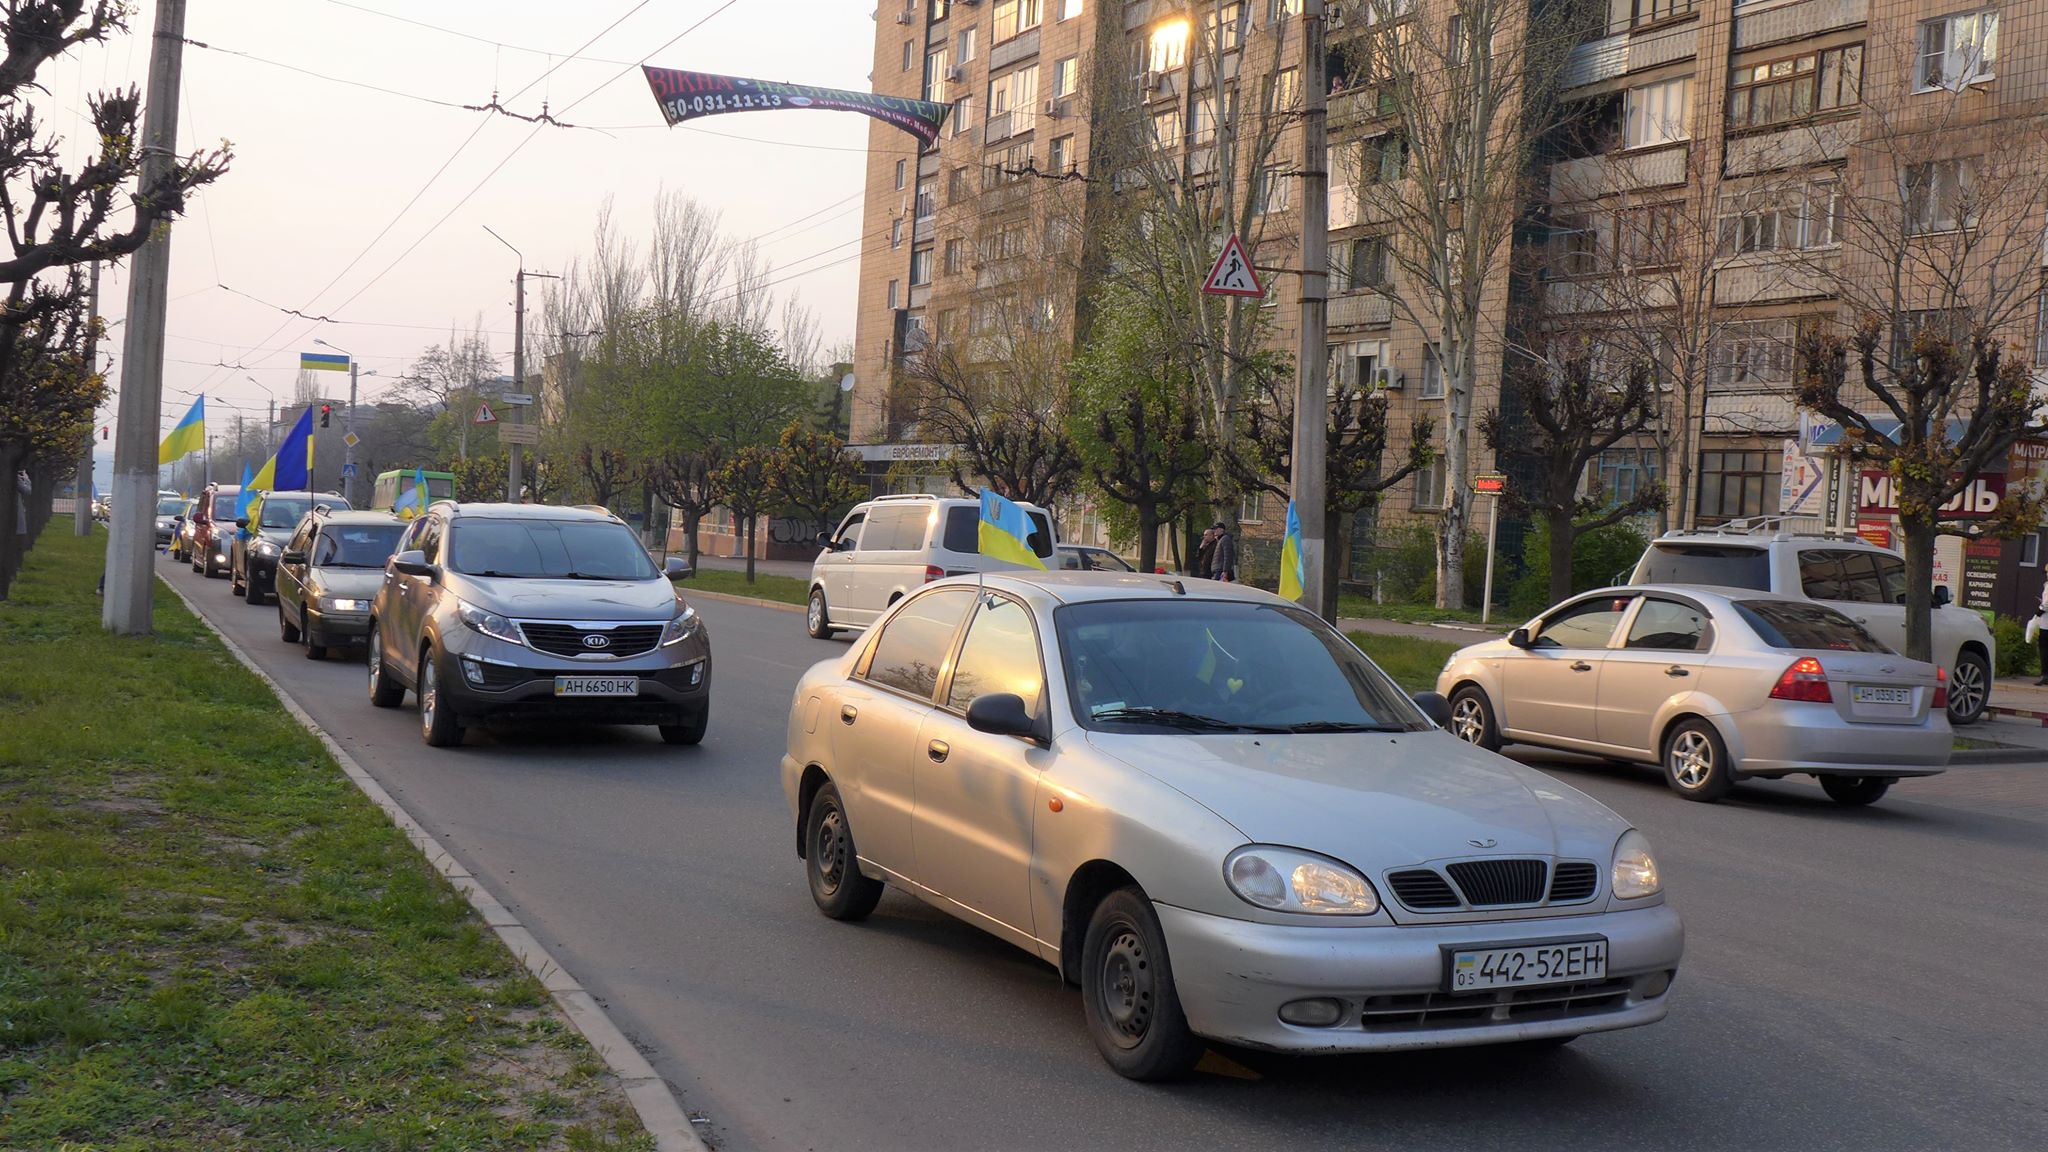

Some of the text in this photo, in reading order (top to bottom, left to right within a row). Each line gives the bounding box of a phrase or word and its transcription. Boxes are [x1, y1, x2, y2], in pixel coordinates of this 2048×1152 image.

[649, 68, 734, 97] ВІКНА
[1829, 458, 1840, 523] РЕМОНТ
[587, 637, 606, 645] KIA
[565, 680, 634, 693] AH 6650 HK
[1479, 945, 1600, 984] 442-52EH
